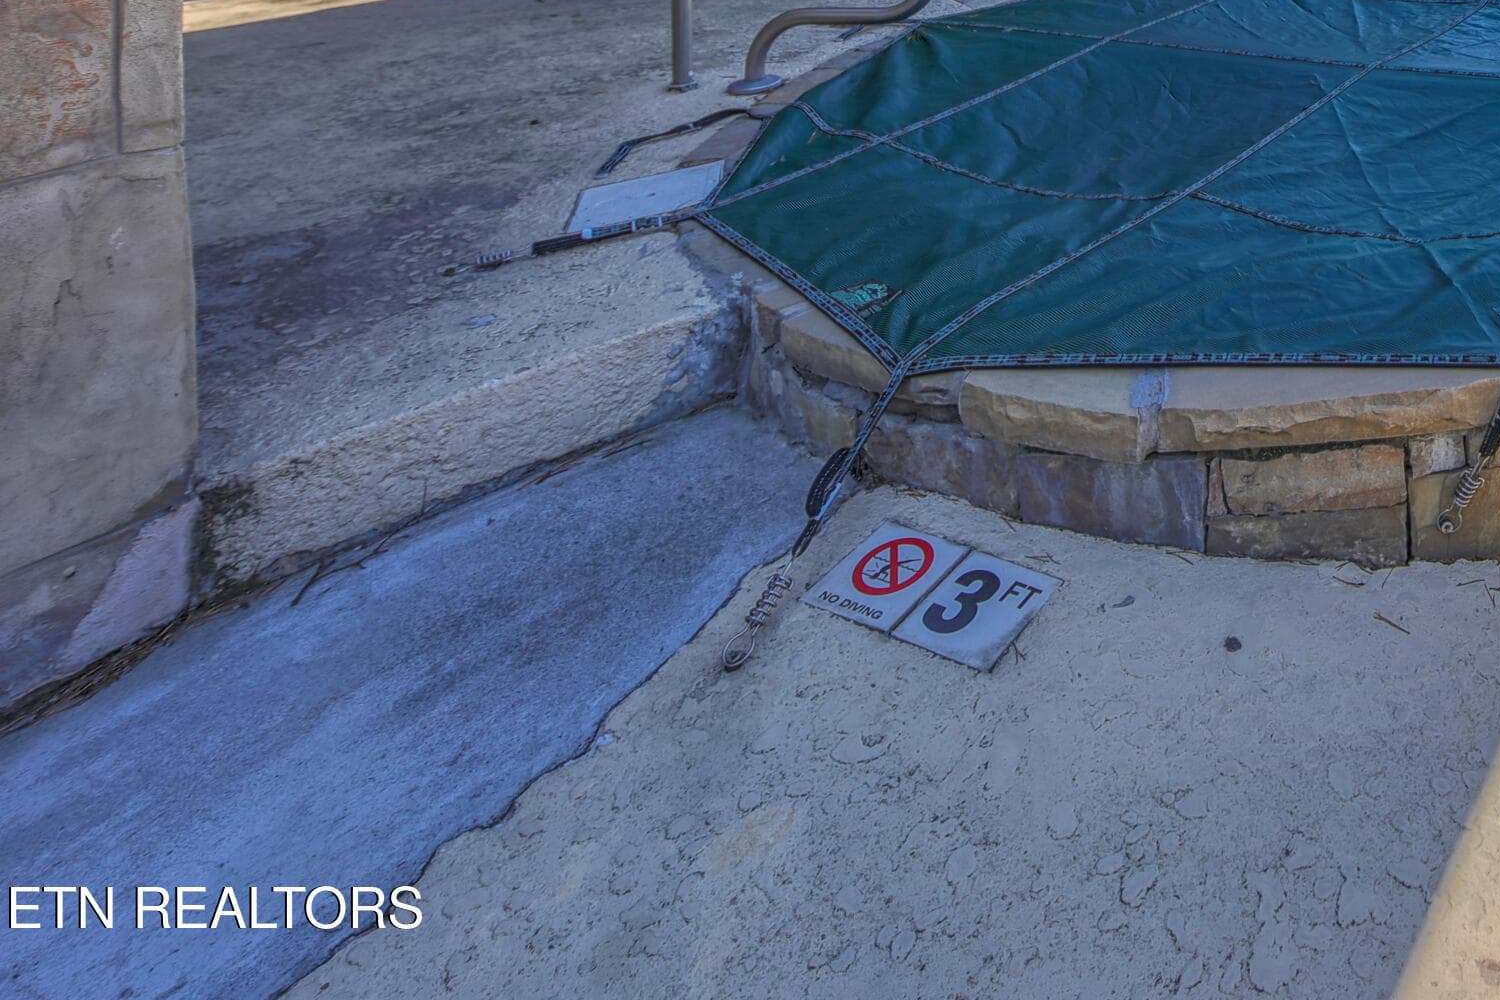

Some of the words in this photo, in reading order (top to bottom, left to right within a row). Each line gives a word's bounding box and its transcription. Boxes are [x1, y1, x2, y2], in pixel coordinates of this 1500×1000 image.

[818, 590, 840, 603] NO
[839, 598, 884, 620] DIVING
[922, 569, 1001, 634] 3
[999, 581, 1043, 609] FT
